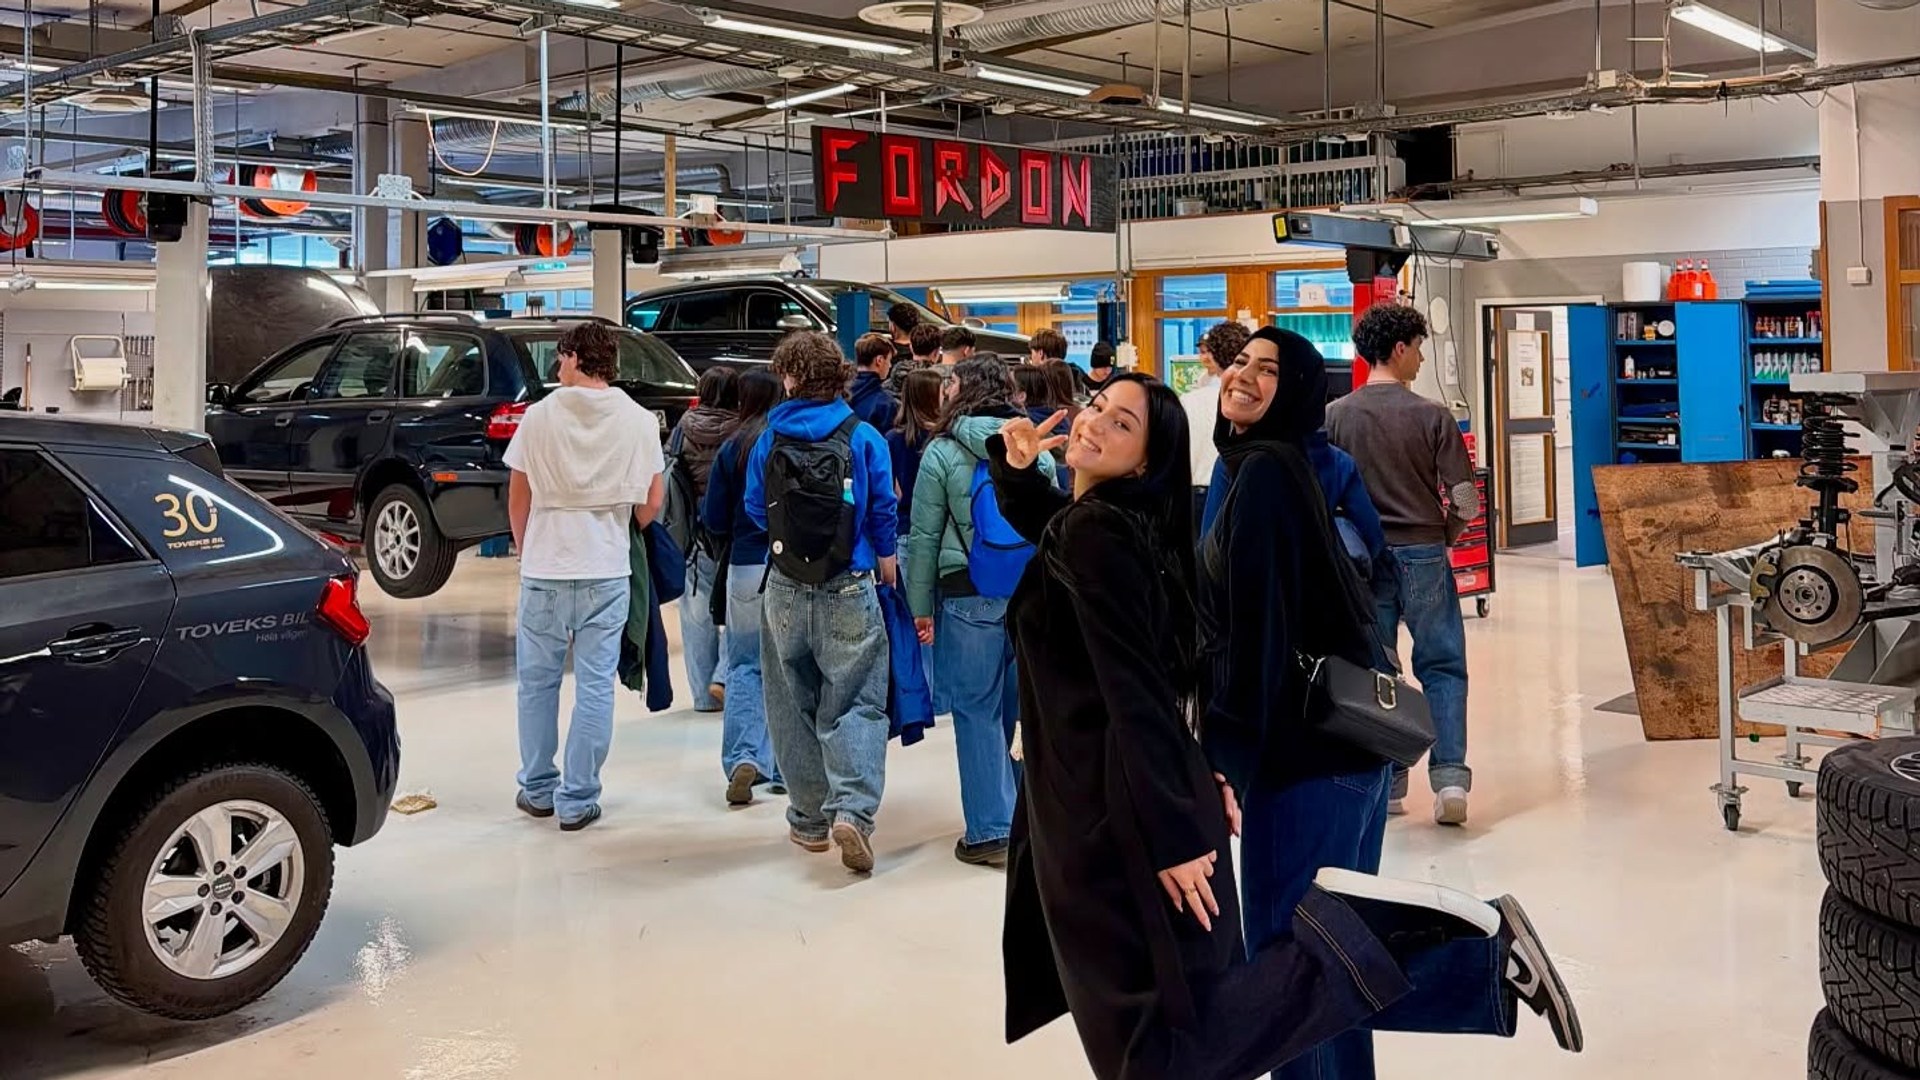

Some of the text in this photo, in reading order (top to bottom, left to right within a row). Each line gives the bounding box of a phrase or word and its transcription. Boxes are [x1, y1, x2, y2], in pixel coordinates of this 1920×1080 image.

[821, 128, 1092, 227] FORDON
[155, 490, 218, 537] 30
[167, 539, 210, 549] TOVEKS
[175, 612, 309, 641] TOVEKS BIL
